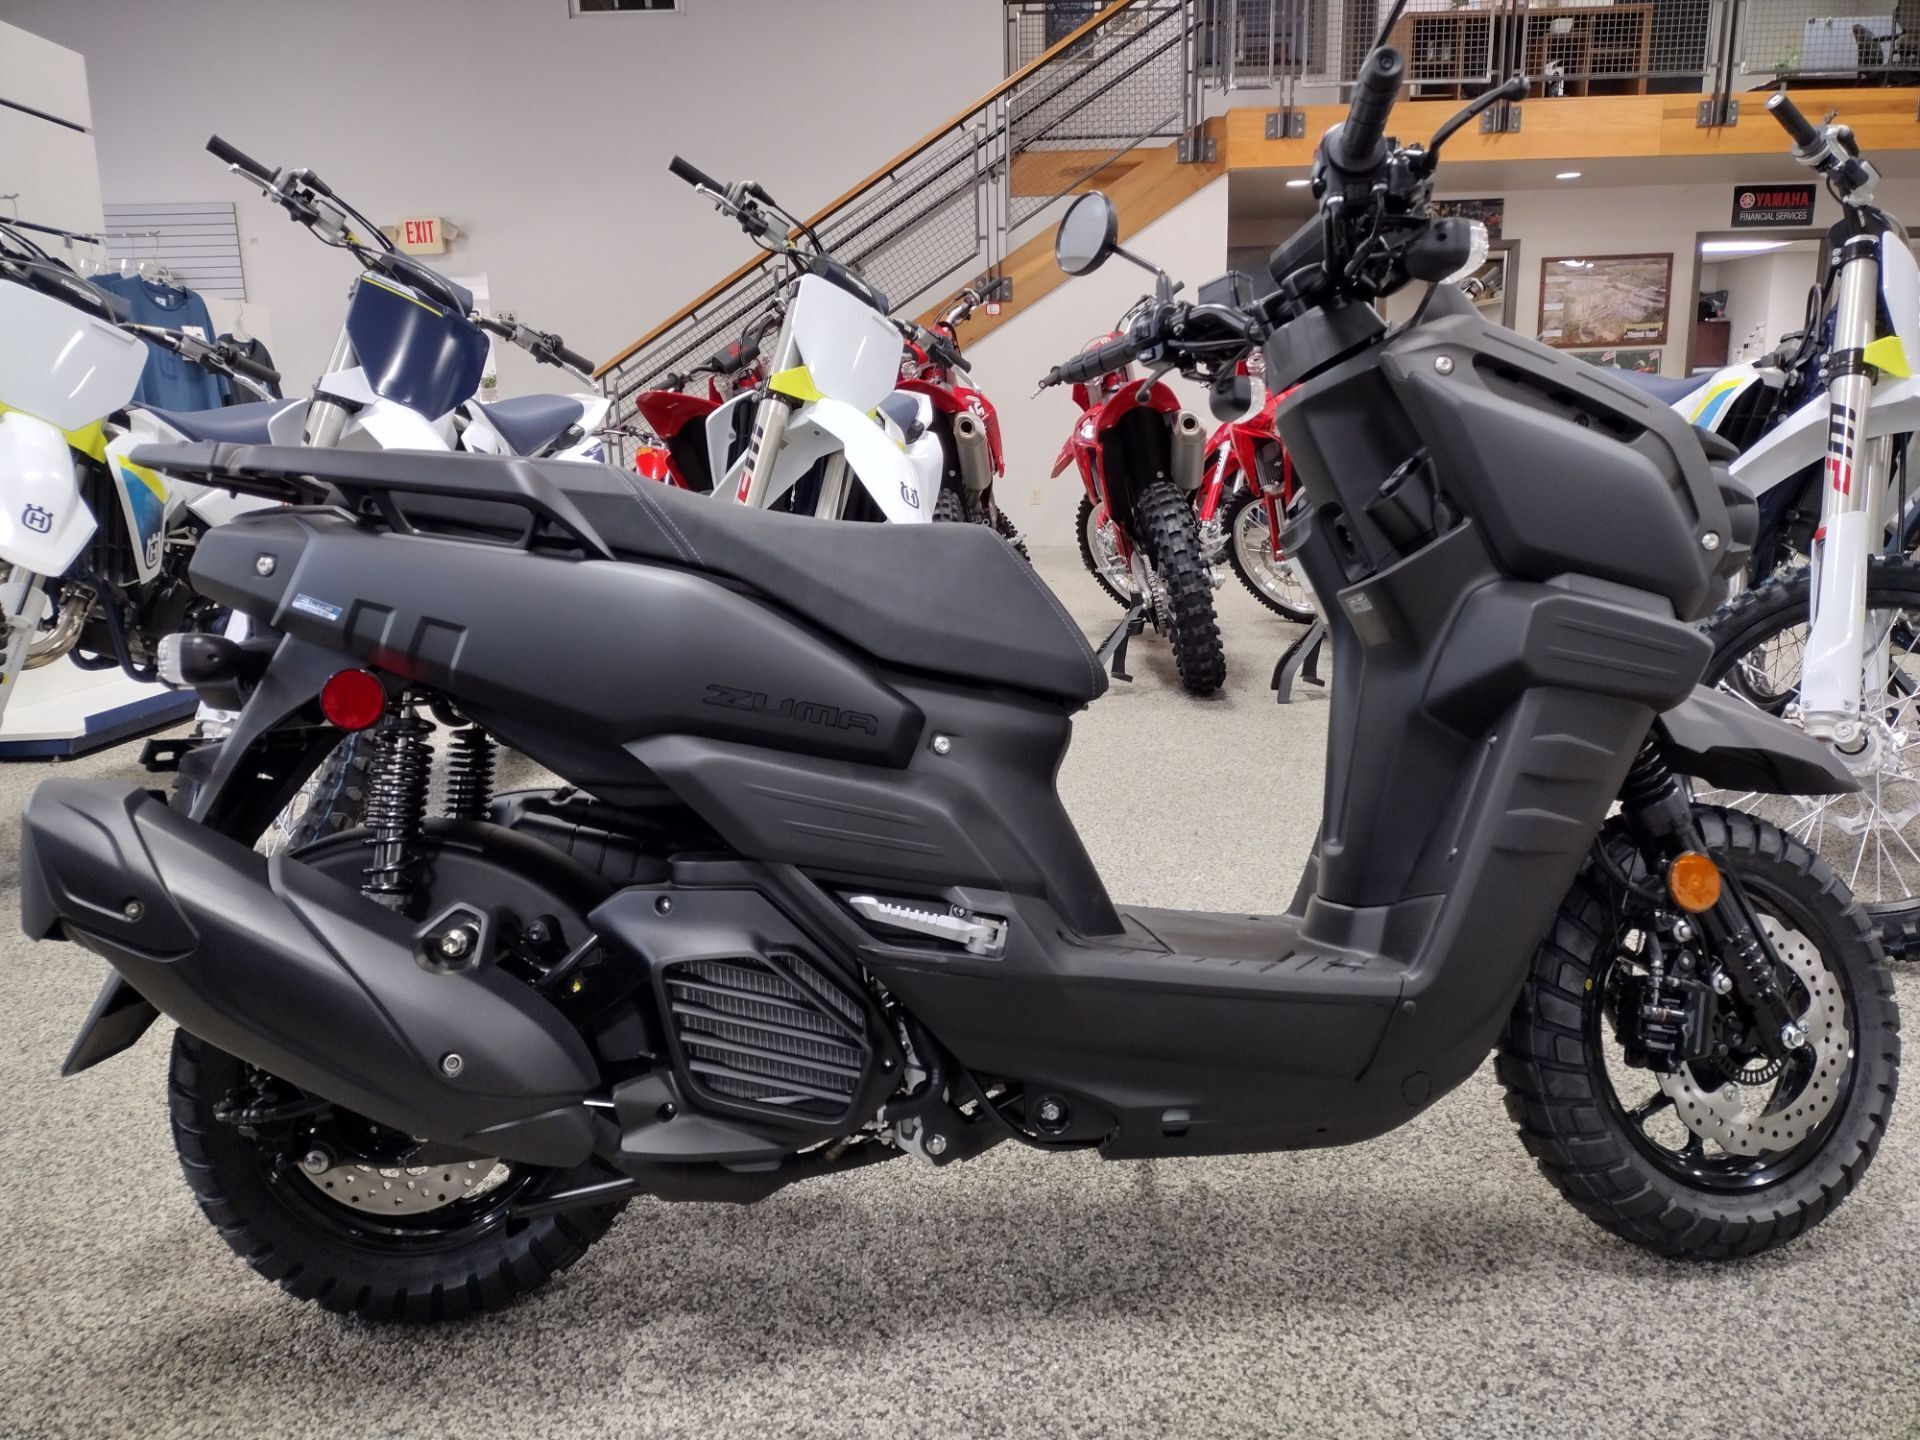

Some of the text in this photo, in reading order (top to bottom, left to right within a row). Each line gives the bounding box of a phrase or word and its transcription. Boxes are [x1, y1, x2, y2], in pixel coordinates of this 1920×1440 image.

[1756, 192, 1809, 207] YAMAHA
[1740, 211, 1807, 221] FINANCIAL SERVICES
[405, 221, 433, 243] EXIT
[702, 684, 879, 736] ZUMA
